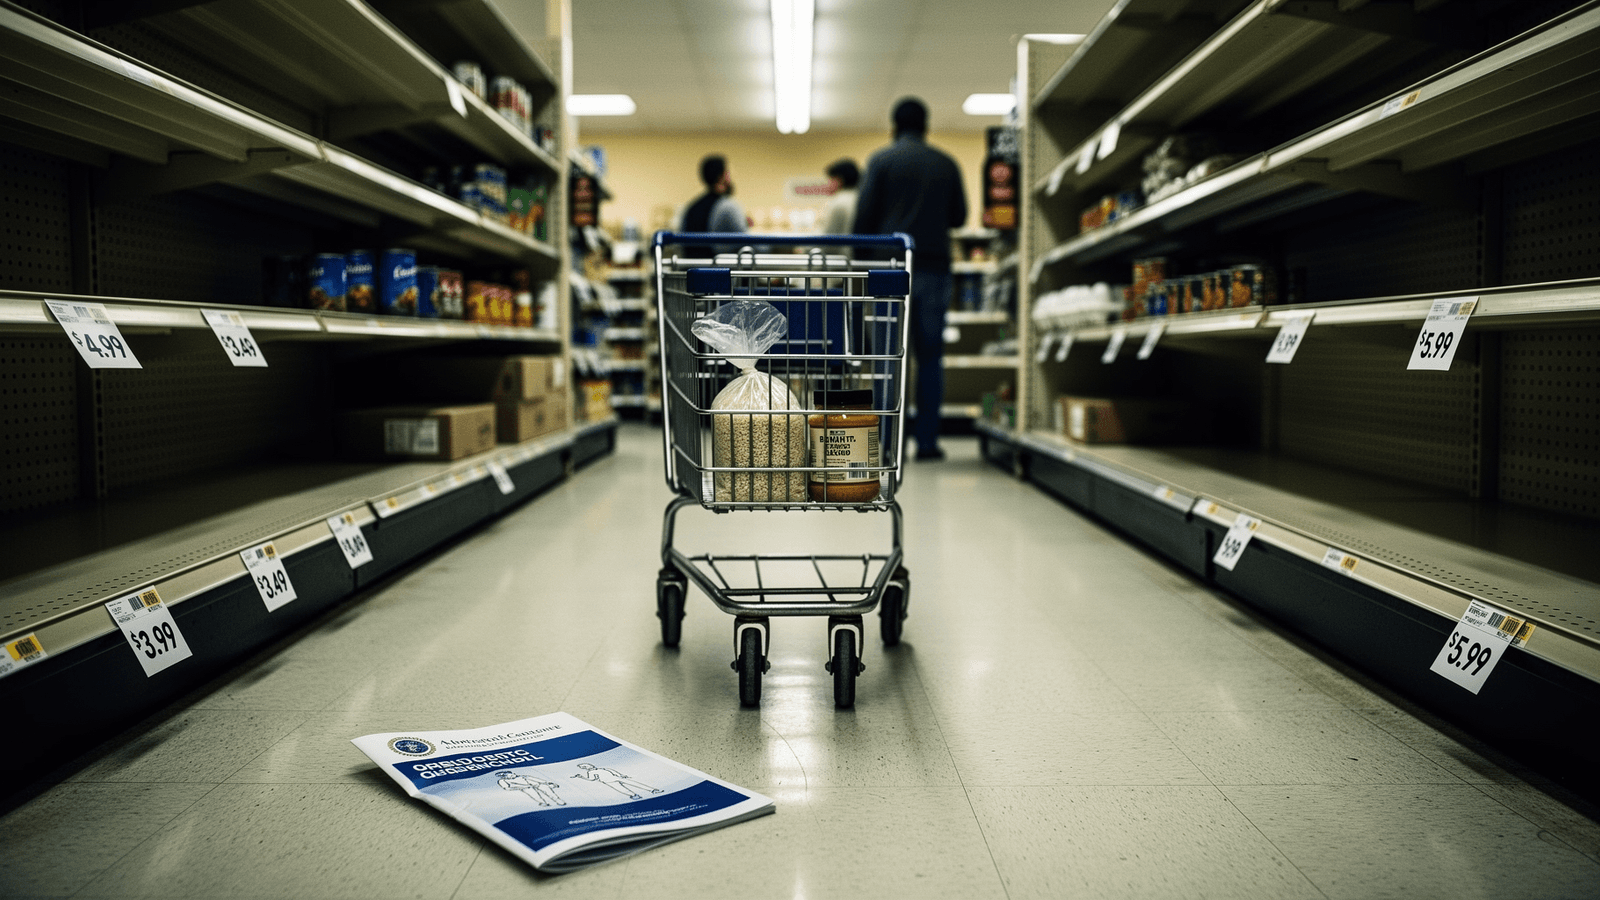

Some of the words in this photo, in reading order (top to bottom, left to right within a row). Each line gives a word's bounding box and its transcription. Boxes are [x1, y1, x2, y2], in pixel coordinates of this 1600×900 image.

[71, 330, 127, 359] $4.99
[221, 335, 257, 358] $3.49
[1419, 329, 1454, 359] $5.99
[256, 569, 289, 599] $3.49
[130, 622, 177, 659] $3.99
[1447, 631, 1492, 676] $5.99
